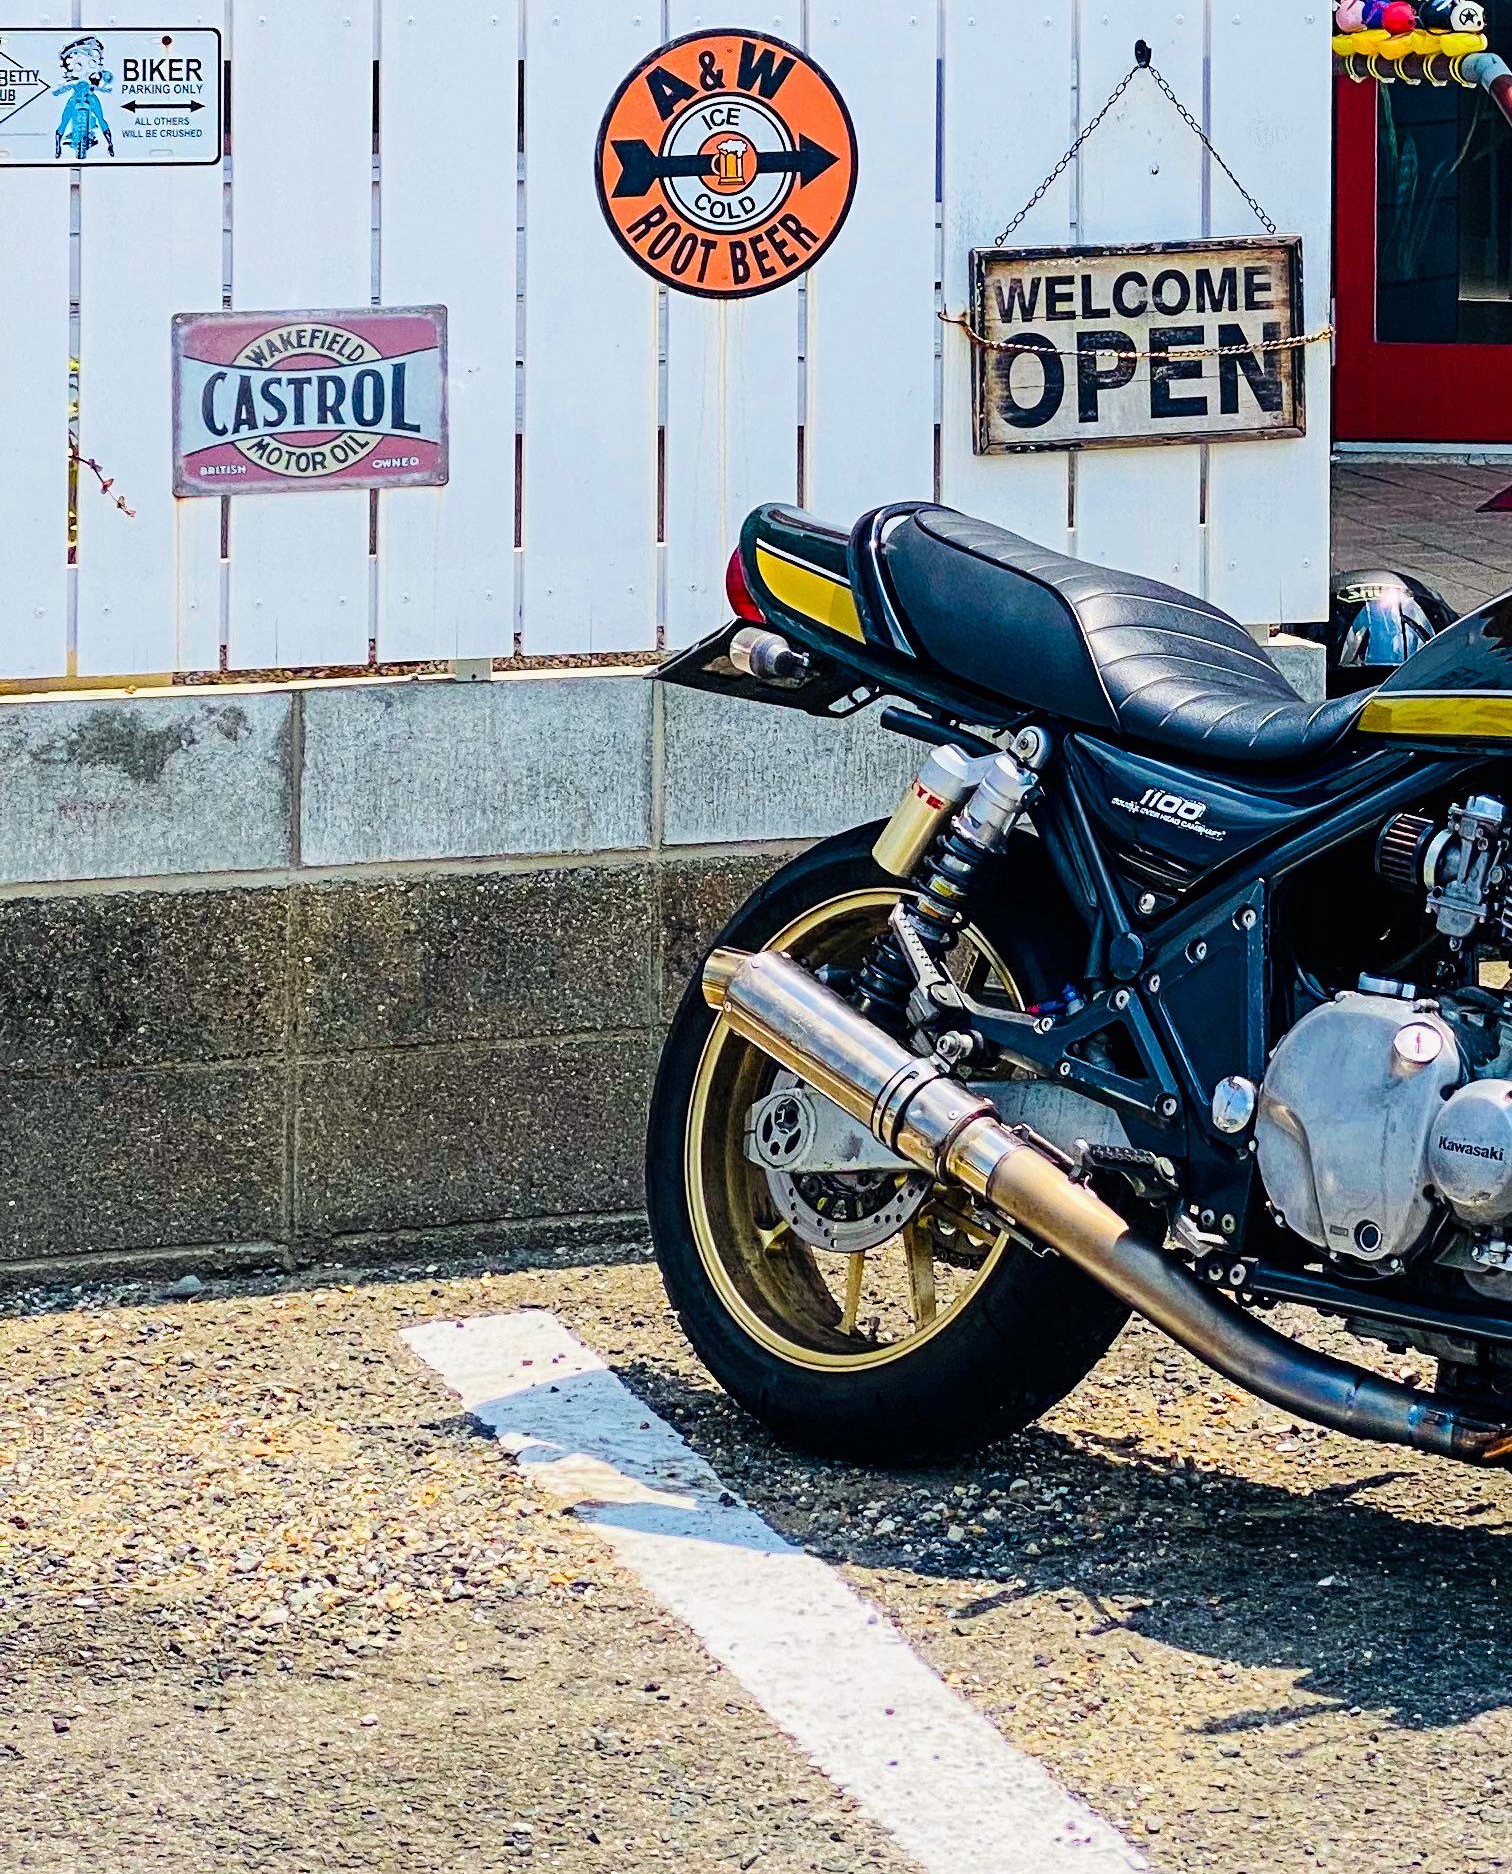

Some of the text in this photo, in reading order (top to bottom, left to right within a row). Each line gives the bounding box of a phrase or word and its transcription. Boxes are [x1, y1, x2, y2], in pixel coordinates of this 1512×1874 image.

[123, 58, 203, 82] BIKER
[645, 40, 797, 122] A&W
[122, 84, 204, 94] PARKING ONLY
[135, 117, 190, 126] ALL OTHERS
[701, 108, 741, 130] ICE
[122, 129, 202, 138] WILL BE CRUSHED
[695, 193, 756, 219] COLD
[626, 204, 820, 285] ROOT BEER
[995, 265, 1274, 324] WELCOME
[245, 329, 365, 367] WAKEFIELD
[1000, 321, 1282, 428] OPEN
[201, 362, 421, 436] CASTROL
[200, 457, 419, 476] BRITISH OWNED
[247, 433, 369, 473] MOTOR OIL
[1140, 789, 1206, 820] 1100
[1439, 1135, 1505, 1161] Kawasaki
